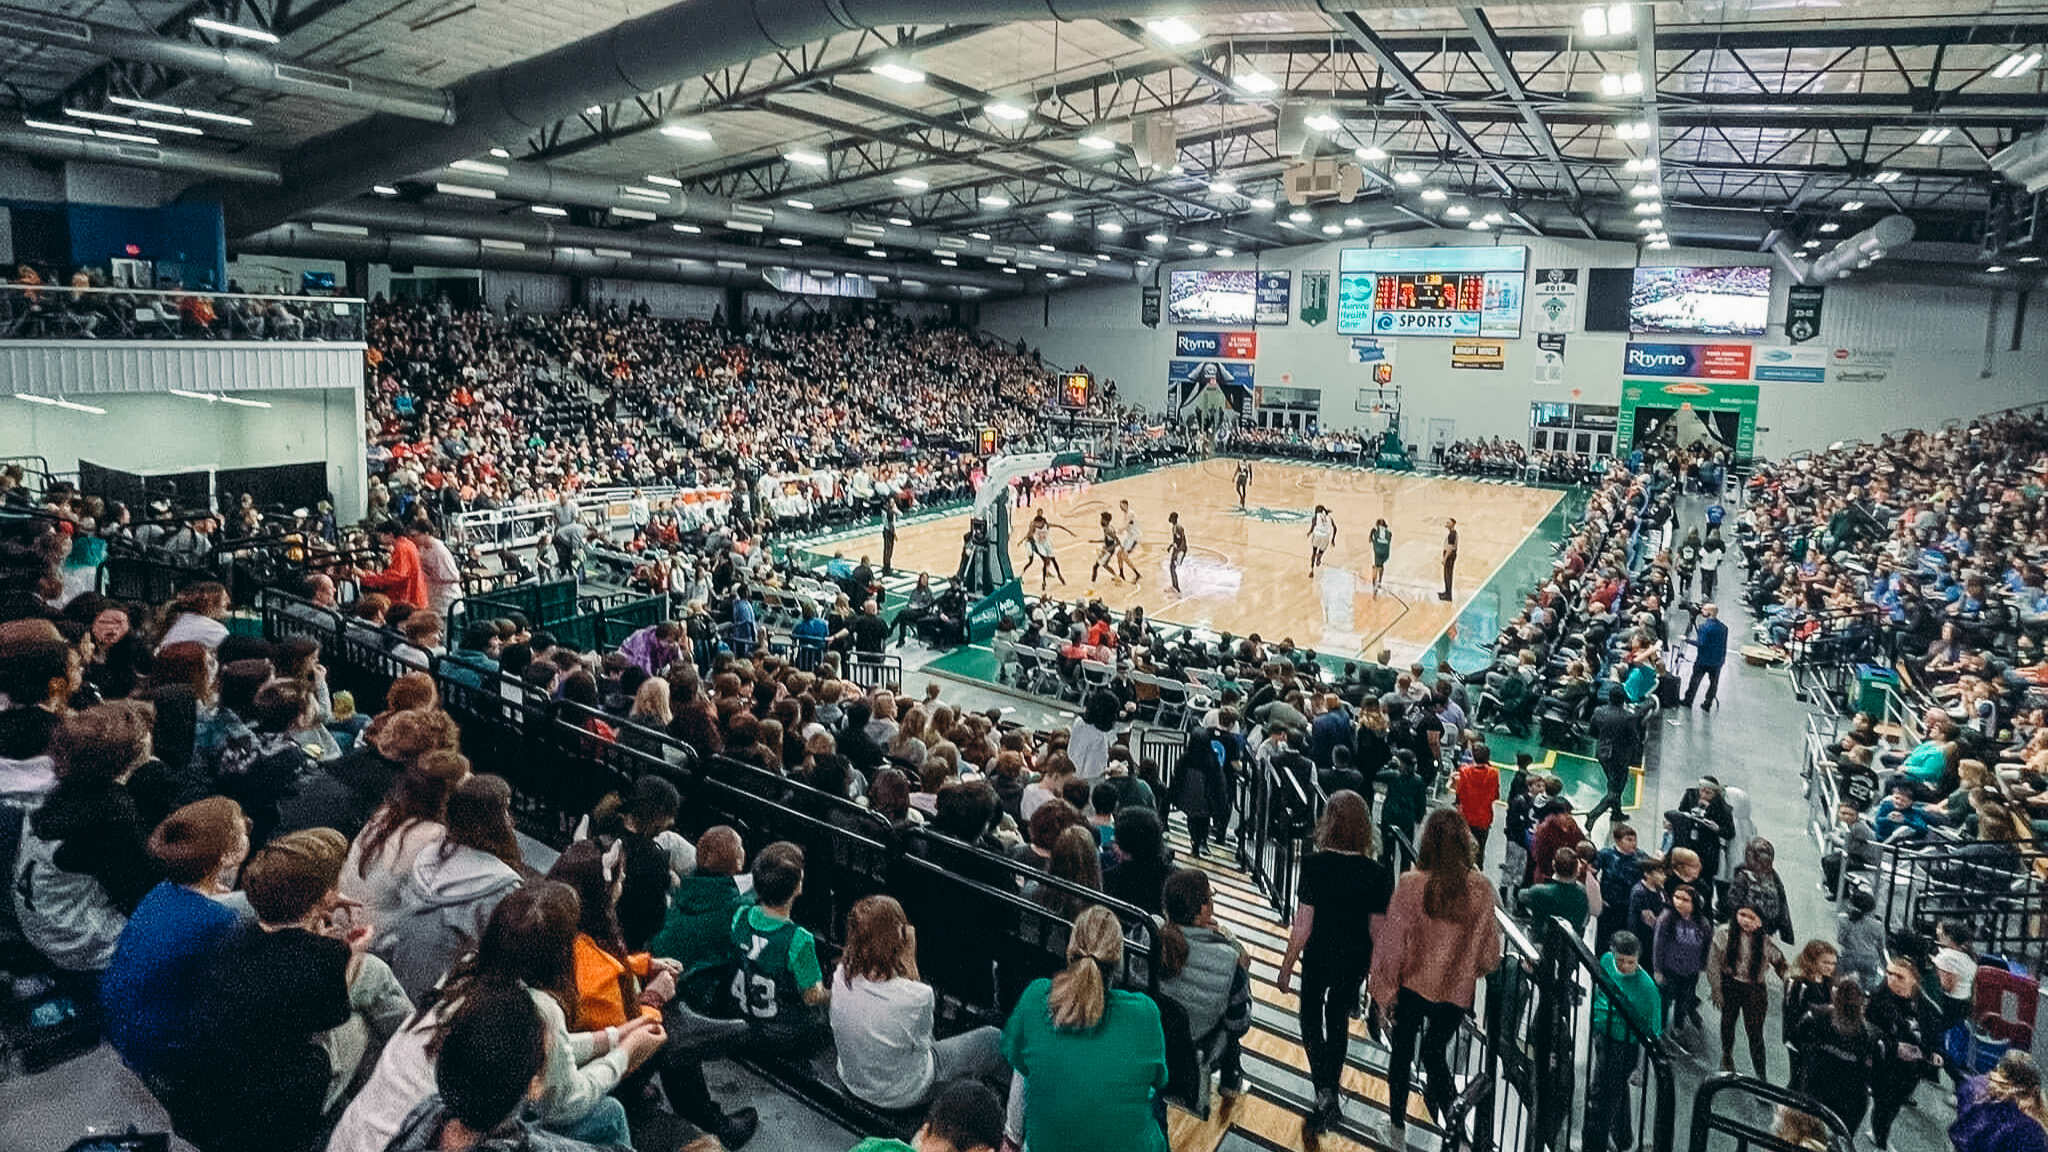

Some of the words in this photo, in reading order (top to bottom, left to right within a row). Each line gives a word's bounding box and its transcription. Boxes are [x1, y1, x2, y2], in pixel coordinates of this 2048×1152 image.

[1340, 310, 1368, 320] Health
[1400, 314, 1453, 328] SPORTS
[1178, 336, 1216, 352] Rhyme
[1628, 349, 1686, 368] Rhyme
[730, 968, 778, 1018] 43
